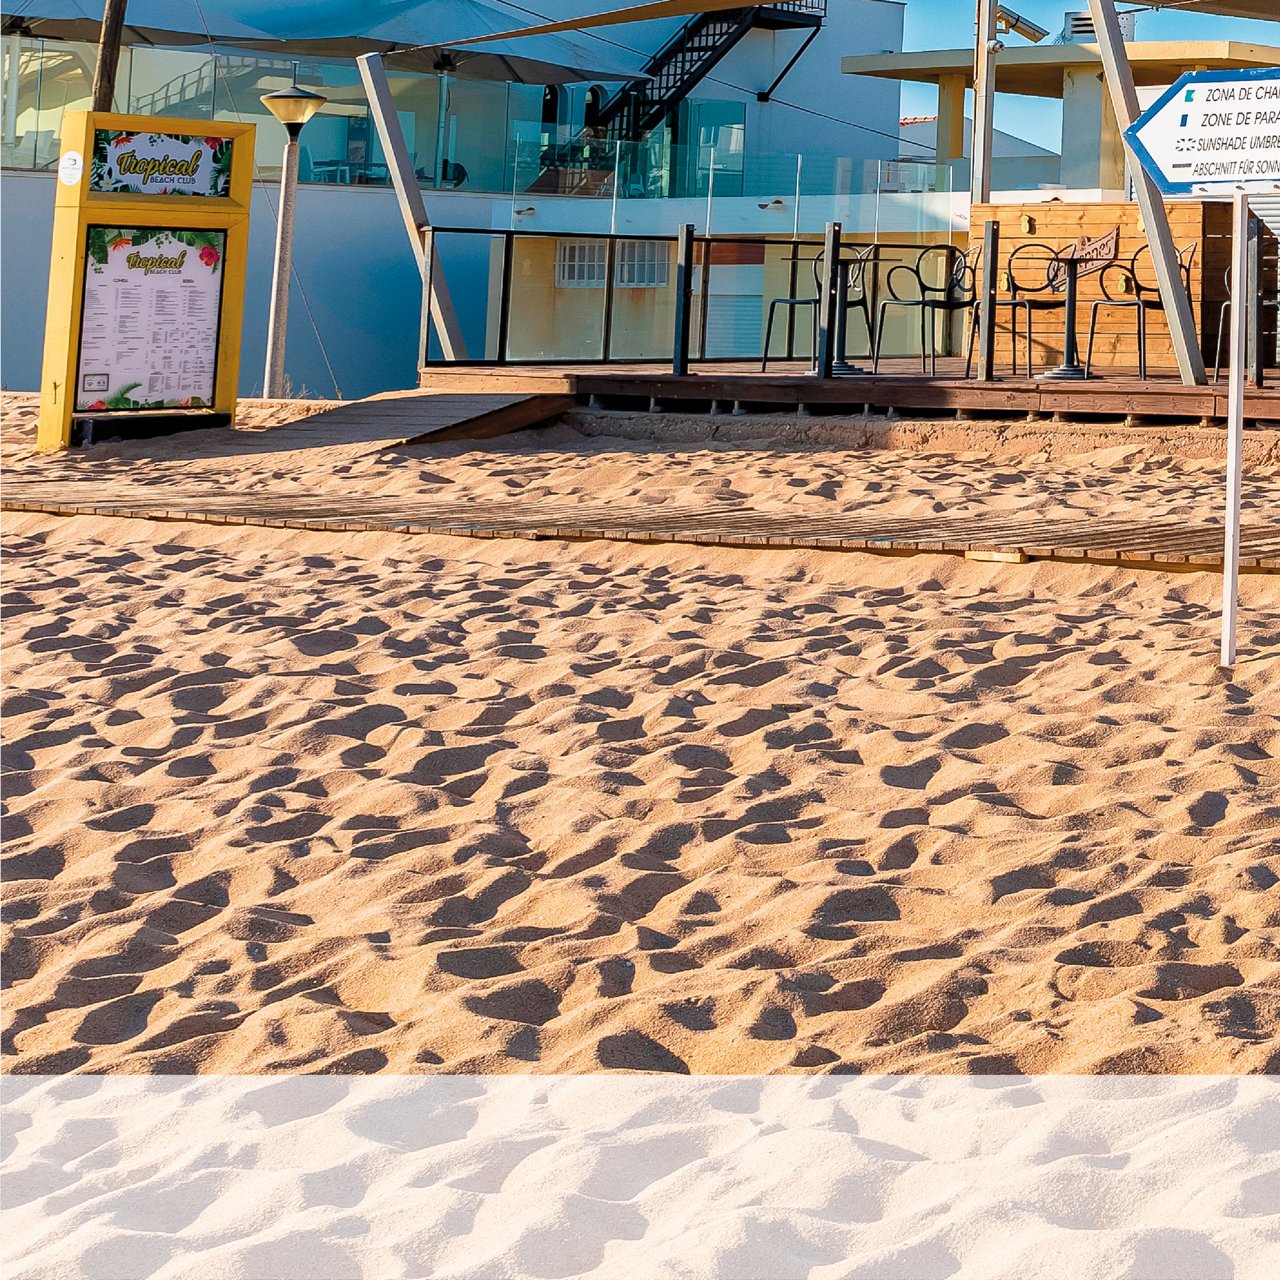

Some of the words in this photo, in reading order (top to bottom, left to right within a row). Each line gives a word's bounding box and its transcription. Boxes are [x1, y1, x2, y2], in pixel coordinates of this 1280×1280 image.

[1206, 89, 1235, 102] ZONA
[1239, 87, 1253, 100] DE
[1201, 113, 1233, 127] ZONE
[1236, 111, 1251, 125] DE
[1197, 136, 1247, 152] SUNSHADE
[116, 148, 203, 185] Tropical
[1192, 162, 1238, 177] ABSCHNITT
[1239, 159, 1255, 175] FÜR
[150, 176, 175, 184] BEACH
[177, 177, 197, 185] CLUB
[126, 250, 187, 276] Tropical
